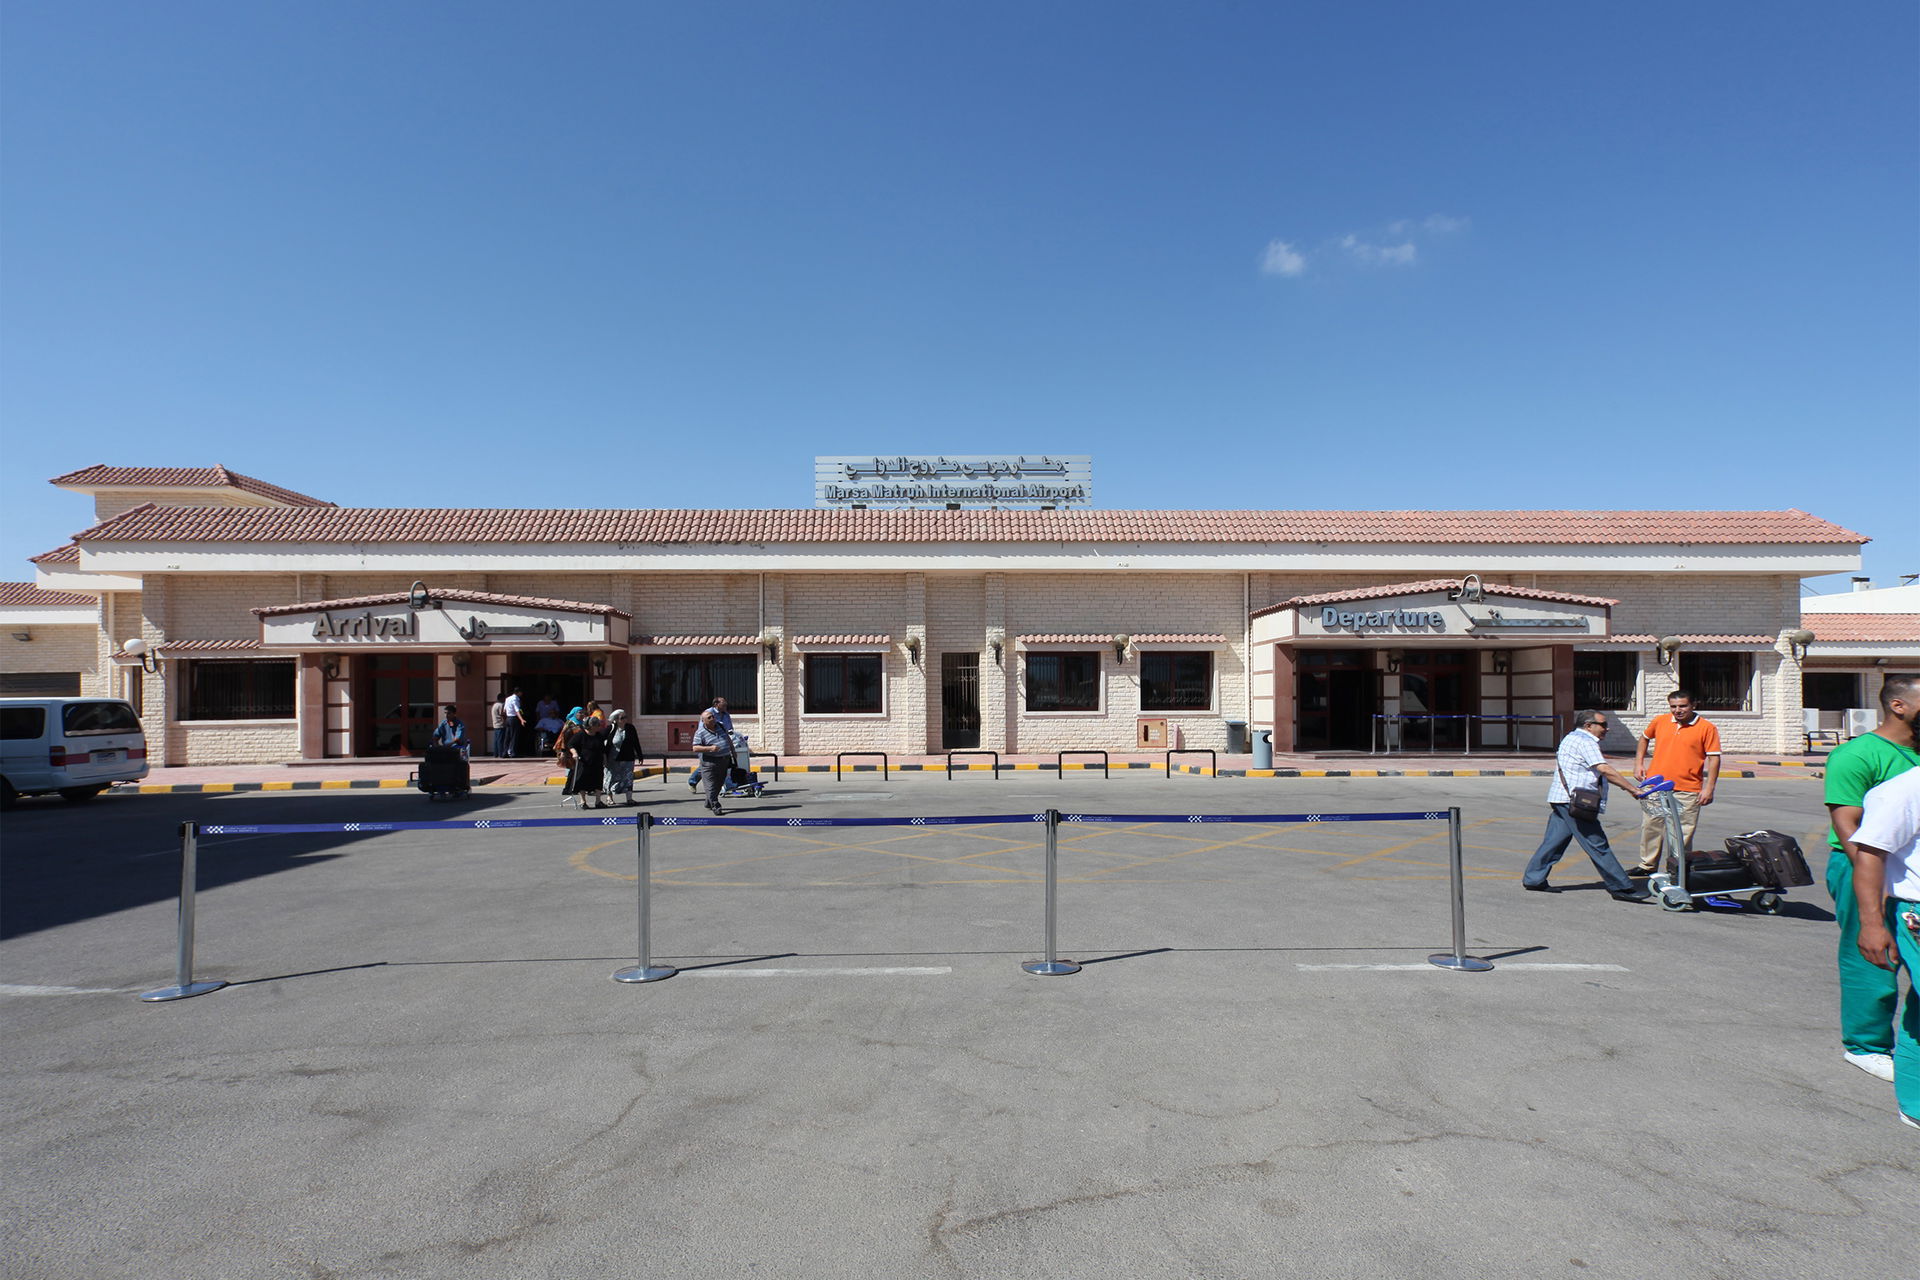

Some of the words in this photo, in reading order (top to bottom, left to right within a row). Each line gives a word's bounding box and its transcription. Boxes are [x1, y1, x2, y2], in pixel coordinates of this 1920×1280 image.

[909, 455, 961, 476] مطروح
[1009, 455, 1064, 475] مطار
[824, 484, 871, 499] Marsa
[871, 484, 925, 499] Matruh
[926, 484, 1026, 499] International
[1028, 484, 1083, 503] Airport
[312, 611, 415, 637] Arrival
[459, 616, 560, 640] وصول
[1321, 607, 1443, 631] Departure
